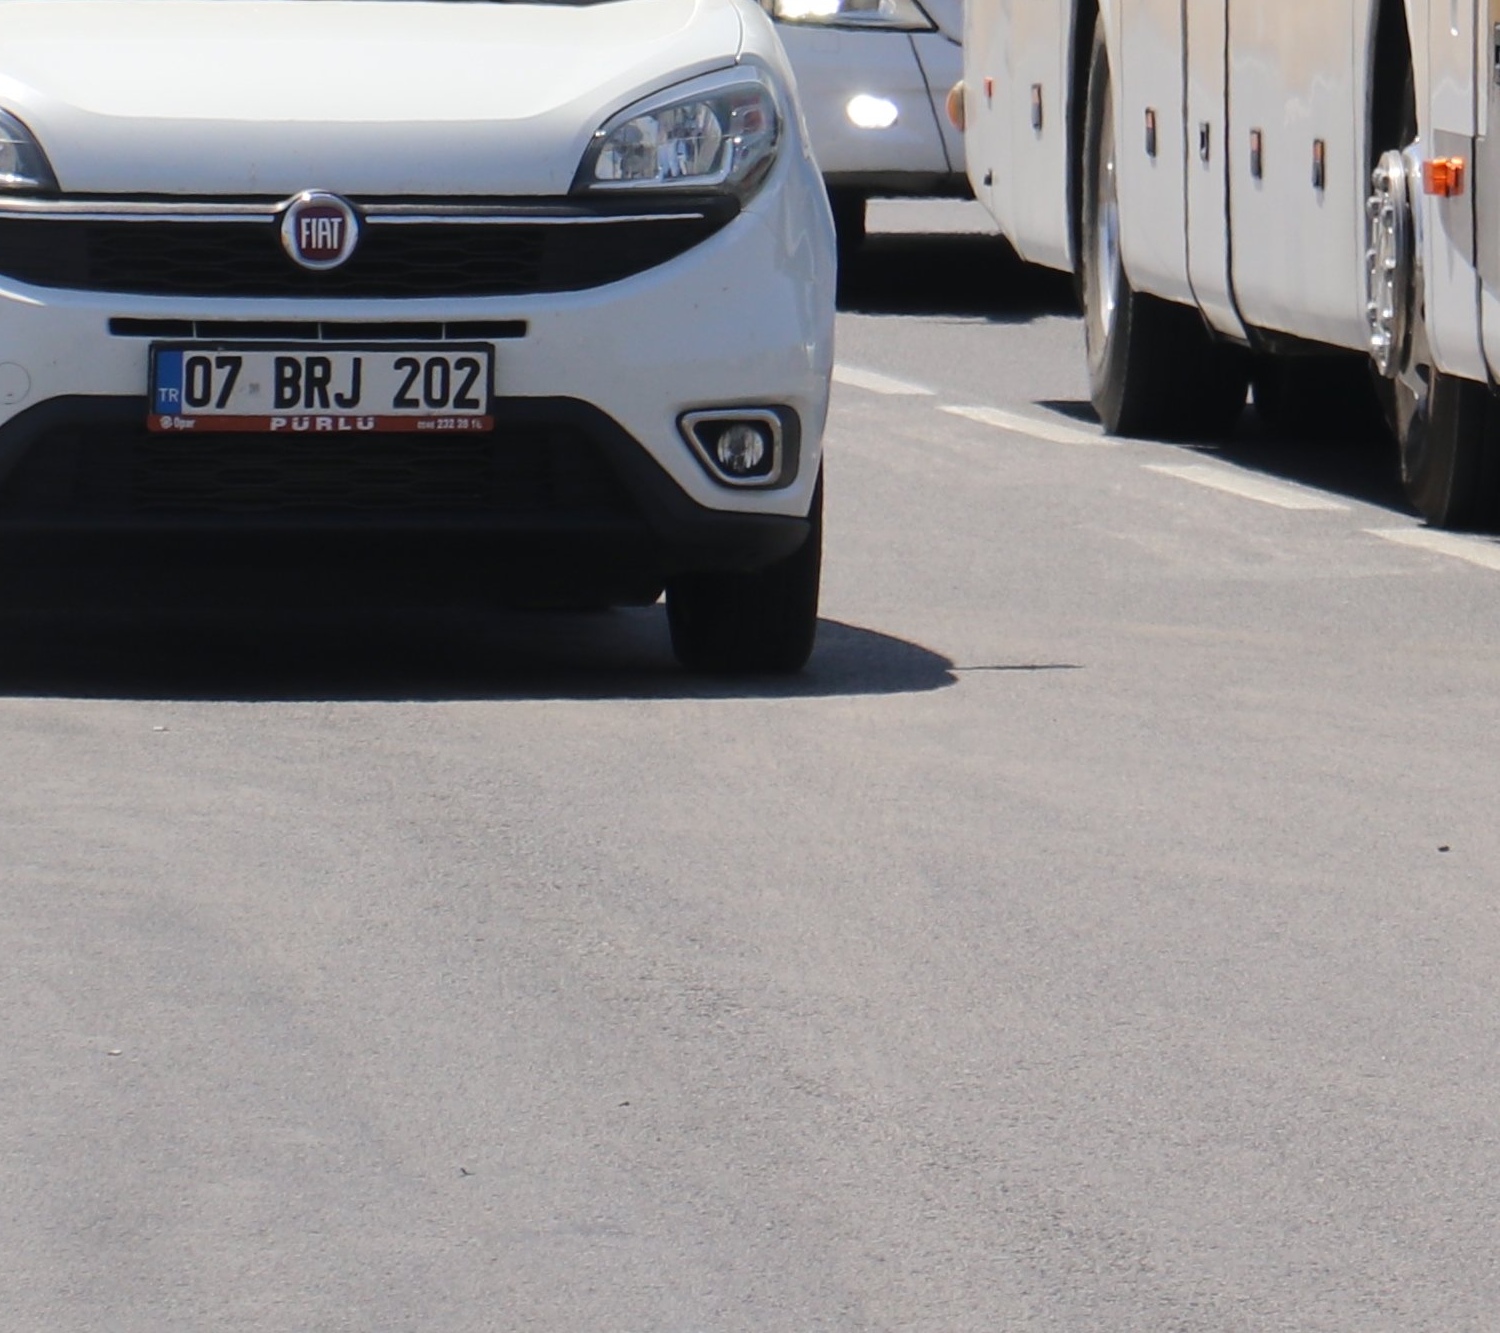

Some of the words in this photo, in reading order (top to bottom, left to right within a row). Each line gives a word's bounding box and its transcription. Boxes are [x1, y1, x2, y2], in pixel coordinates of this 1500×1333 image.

[301, 218, 342, 250] FIAT
[159, 388, 179, 402] TR
[185, 356, 242, 409] 07
[274, 357, 361, 409] BRJ
[393, 357, 480, 409] 202
